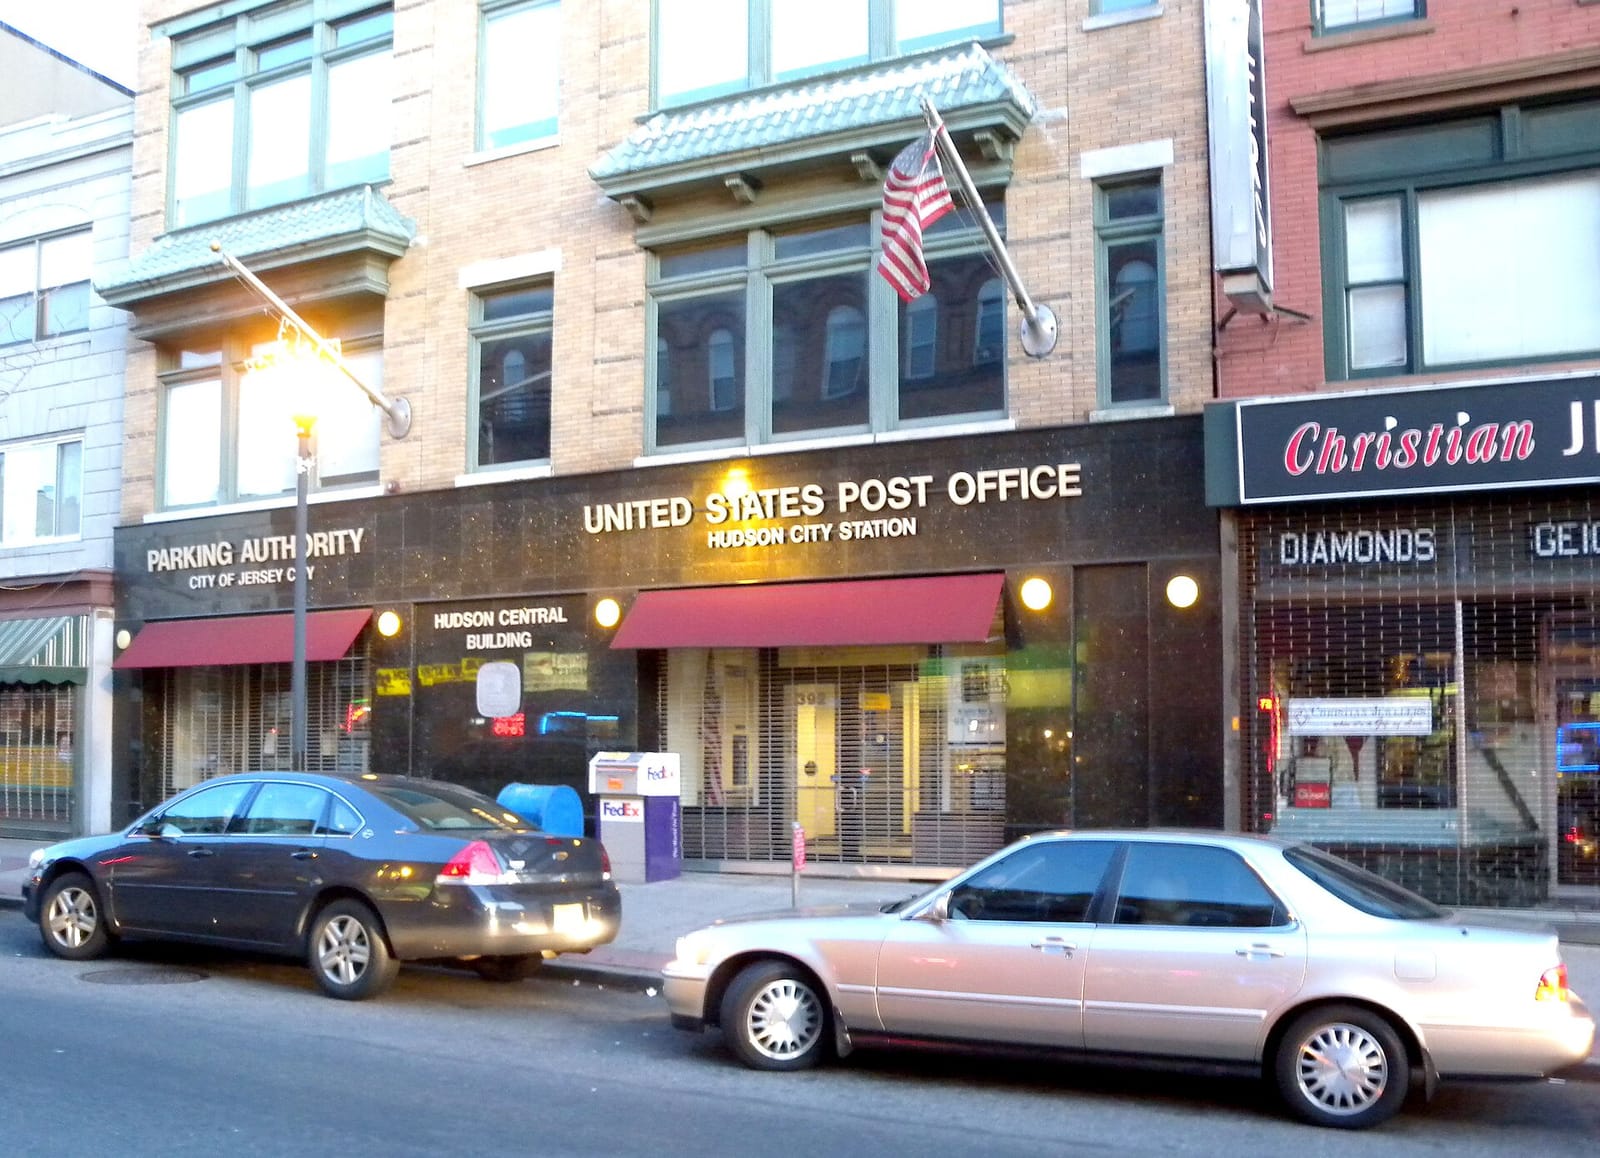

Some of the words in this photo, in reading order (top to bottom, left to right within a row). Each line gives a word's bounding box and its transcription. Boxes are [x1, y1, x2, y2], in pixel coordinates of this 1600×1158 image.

[1284, 411, 1535, 476] Christian
[583, 496, 693, 534] UNITED
[705, 484, 825, 524] STATES
[838, 475, 934, 513] POST
[948, 463, 1082, 506] OFFICE
[707, 526, 784, 549] HUDSON
[790, 522, 832, 544] CITY
[839, 517, 917, 541] STATION
[1280, 528, 1435, 565] DIAMONDS
[147, 541, 233, 573] PARKING
[188, 574, 215, 590] CITY
[218, 572, 235, 588] OF
[237, 568, 284, 586] JERSEY
[286, 566, 315, 583] CY
[434, 611, 494, 629] HUDSON
[499, 606, 568, 626] CENTRAL
[466, 631, 532, 650] BUILDING
[647, 766, 674, 781] FedE
[603, 802, 640, 817] FedEx
